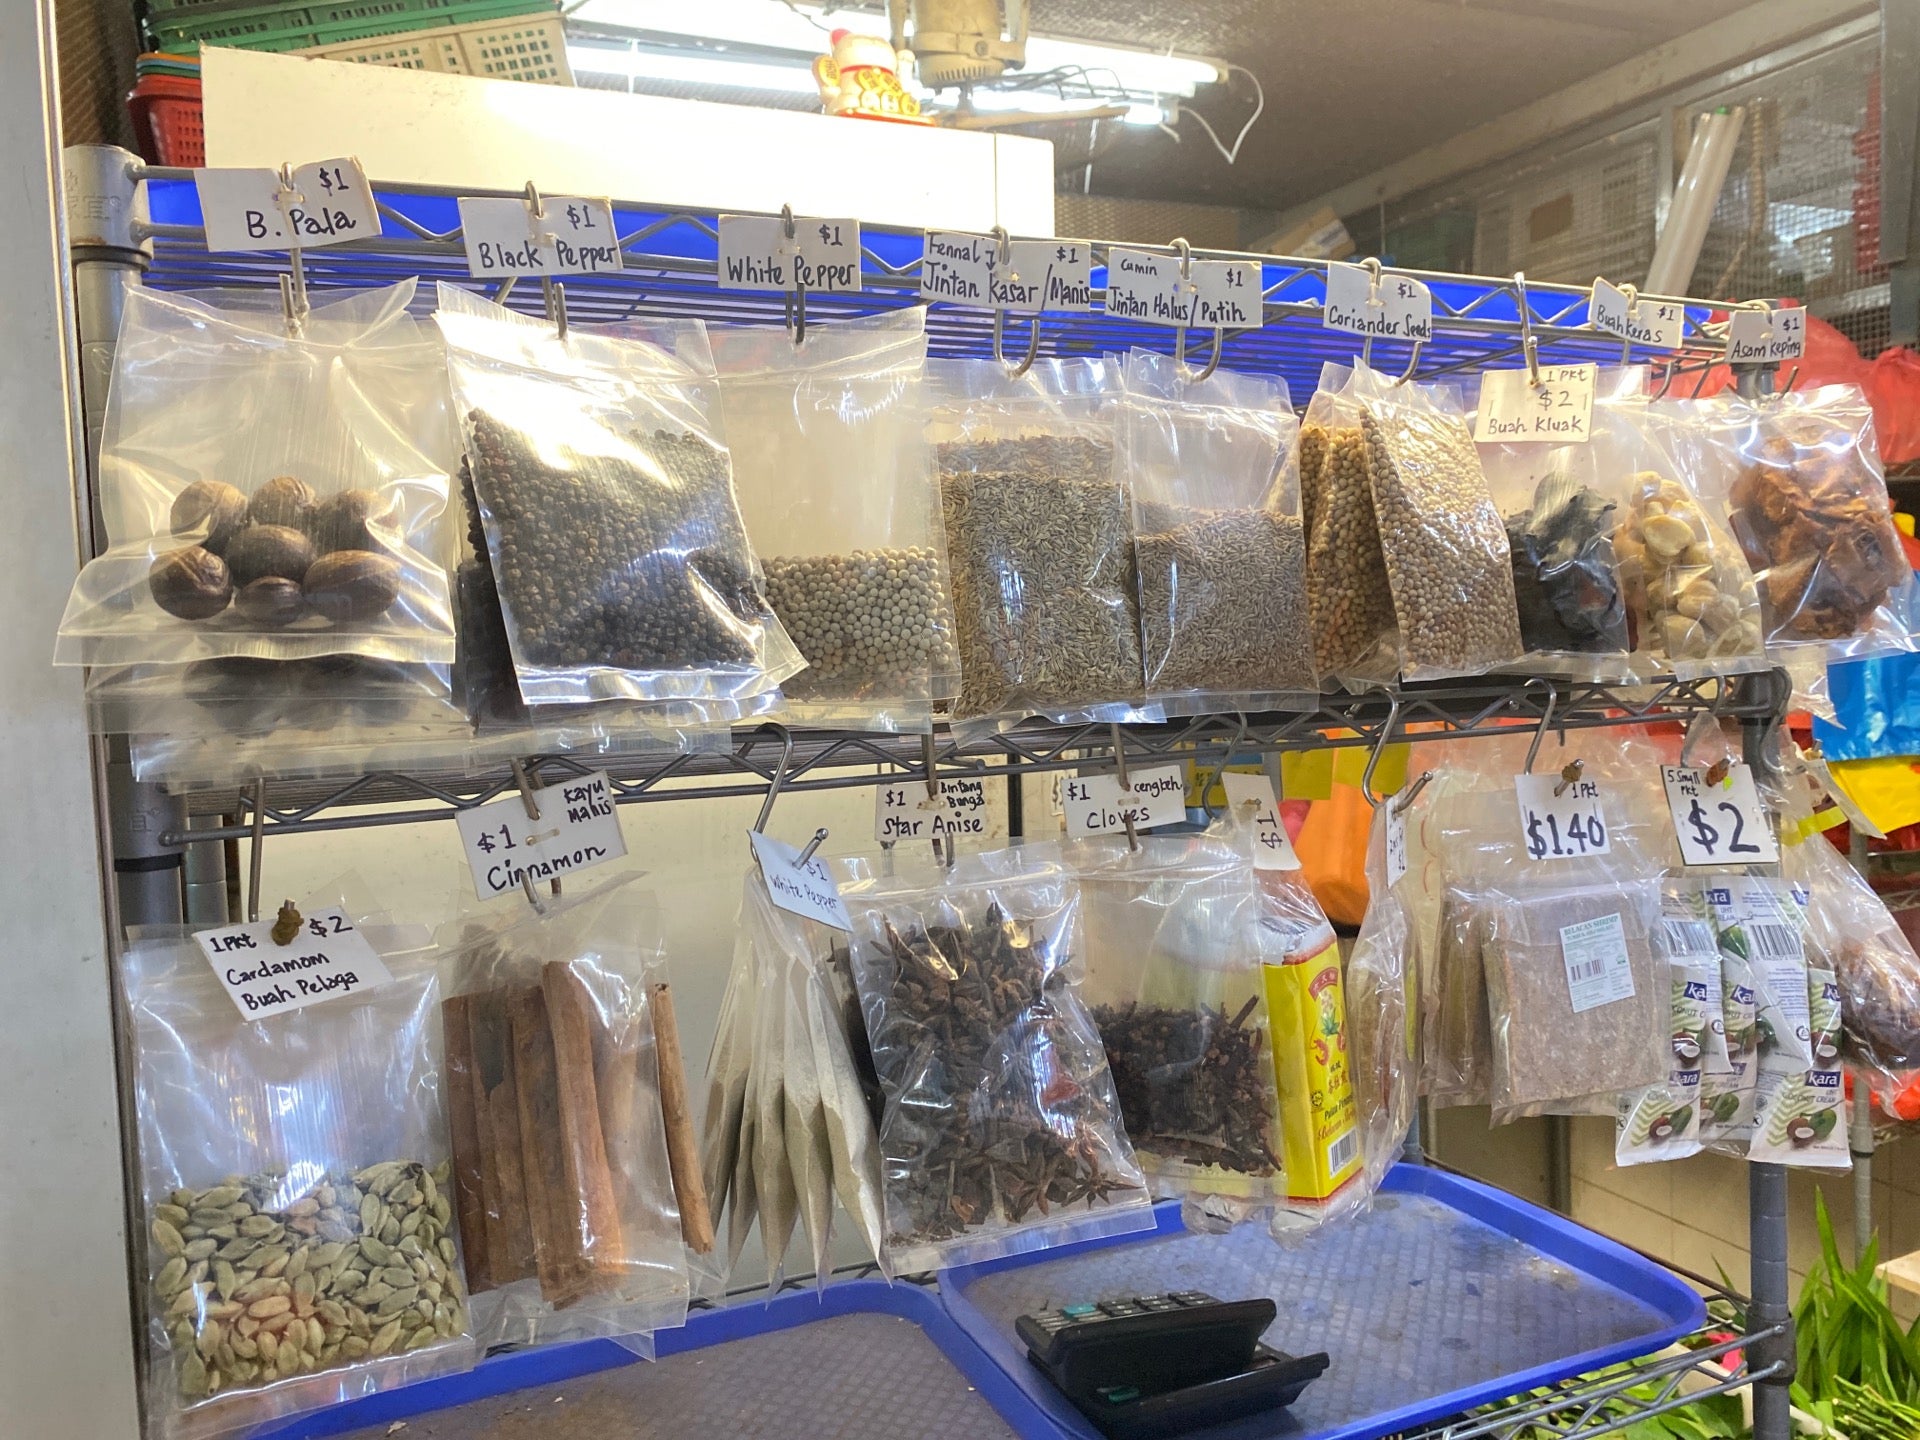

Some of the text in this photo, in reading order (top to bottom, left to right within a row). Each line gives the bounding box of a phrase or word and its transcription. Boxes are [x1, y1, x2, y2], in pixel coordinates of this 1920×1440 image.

[319, 167, 350, 197] $1
[245, 207, 357, 239] B. Pala
[566, 204, 596, 230] $1
[818, 223, 843, 247] $1
[926, 231, 981, 264] Fennal
[478, 238, 618, 271] Black Pepper
[1055, 246, 1079, 264] $1
[726, 254, 856, 291] White Pepper
[922, 260, 980, 298] Jintan
[1225, 267, 1244, 289] $1
[1106, 286, 1148, 318] Jintan
[1397, 281, 1417, 299] $1
[1328, 304, 1432, 339] Coriander Seeds
[1657, 305, 1675, 322] $1
[1782, 316, 1801, 331] $1
[1730, 339, 1767, 360] Asam
[1537, 389, 1573, 411] $2
[1487, 416, 1528, 435] Buah
[940, 779, 983, 796] Bintang
[1667, 769, 1675, 783] 5
[884, 789, 907, 808] $1
[946, 794, 986, 811] Bunga
[1066, 782, 1092, 801] $1
[1572, 782, 1580, 799] 1
[567, 796, 612, 824] Manis
[1086, 806, 1151, 829] Cloves
[882, 811, 984, 838] Star Anise
[1256, 809, 1284, 850] $1
[1527, 810, 1605, 860] $1.40
[1688, 798, 1761, 856] $2
[477, 823, 517, 854] $1
[486, 846, 607, 891] Cinnamon
[309, 915, 354, 938] $2
[225, 952, 331, 986] Cardamom
[240, 970, 360, 1011] Buah Pelaga
[1809, 1071, 1838, 1087] kara
